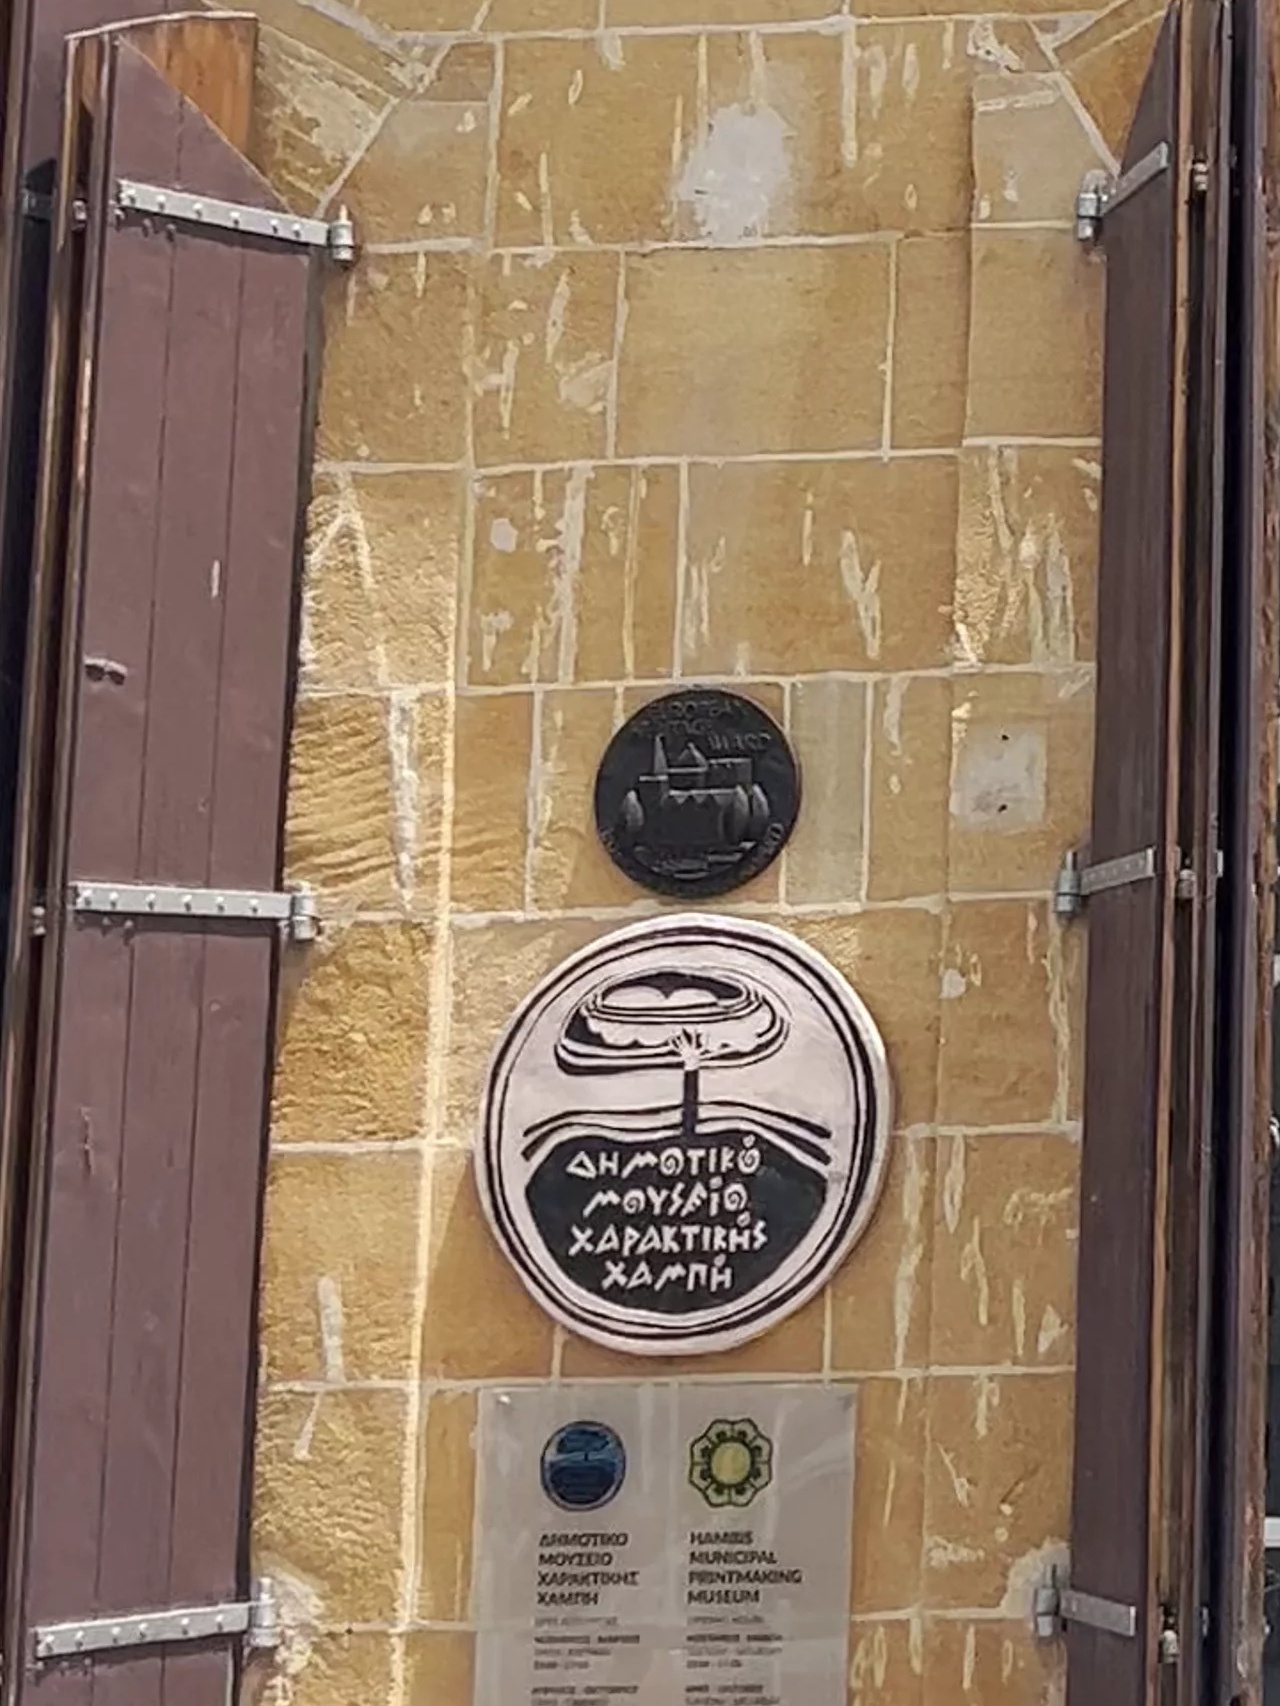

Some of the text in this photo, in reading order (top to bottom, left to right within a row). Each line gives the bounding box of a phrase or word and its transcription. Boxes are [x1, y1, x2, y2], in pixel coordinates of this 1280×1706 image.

[689, 1550, 778, 1565] MUNICIPAL
[688, 1568, 803, 1585] PRINTMAKING
[687, 1589, 760, 1605] MUSEUM
